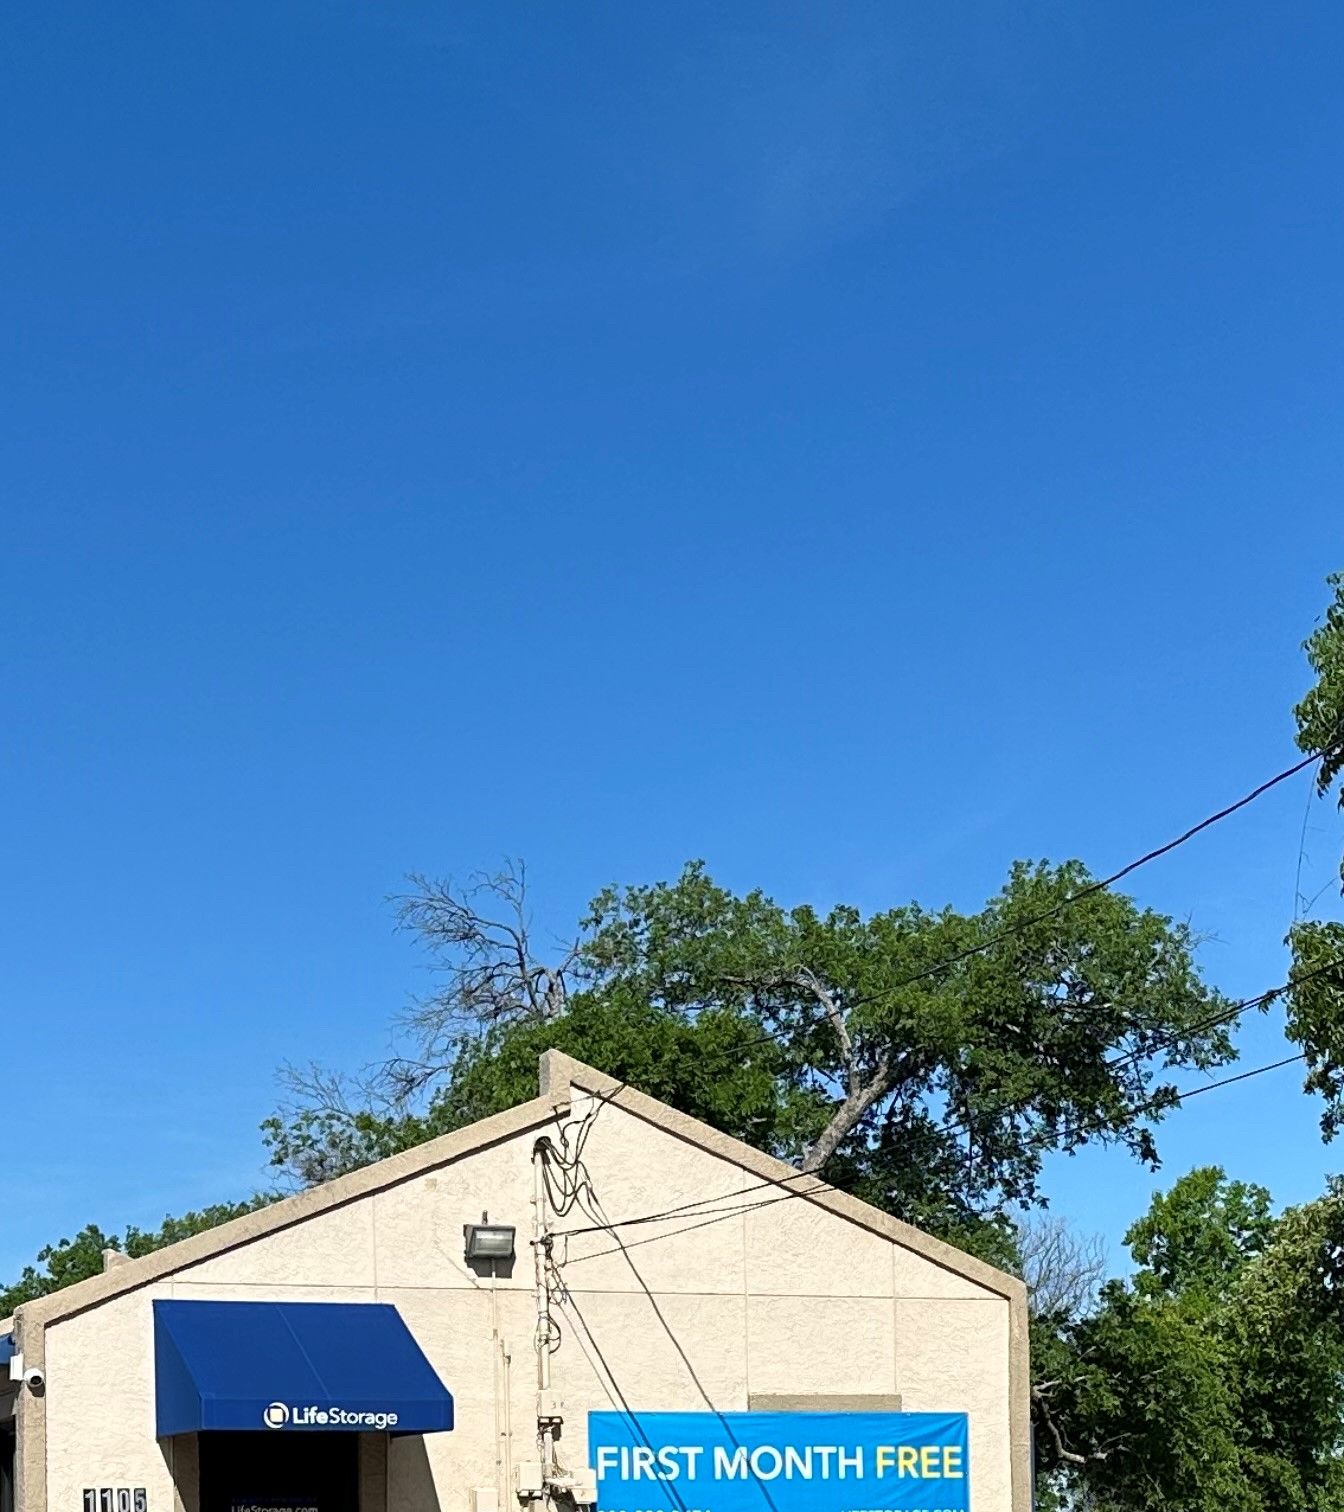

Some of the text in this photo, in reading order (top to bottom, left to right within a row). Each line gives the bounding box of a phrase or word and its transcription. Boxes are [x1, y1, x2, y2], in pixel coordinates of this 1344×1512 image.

[292, 1407, 398, 1429] LifeStorage
[597, 1445, 963, 1481] FIRST MONTH FREE
